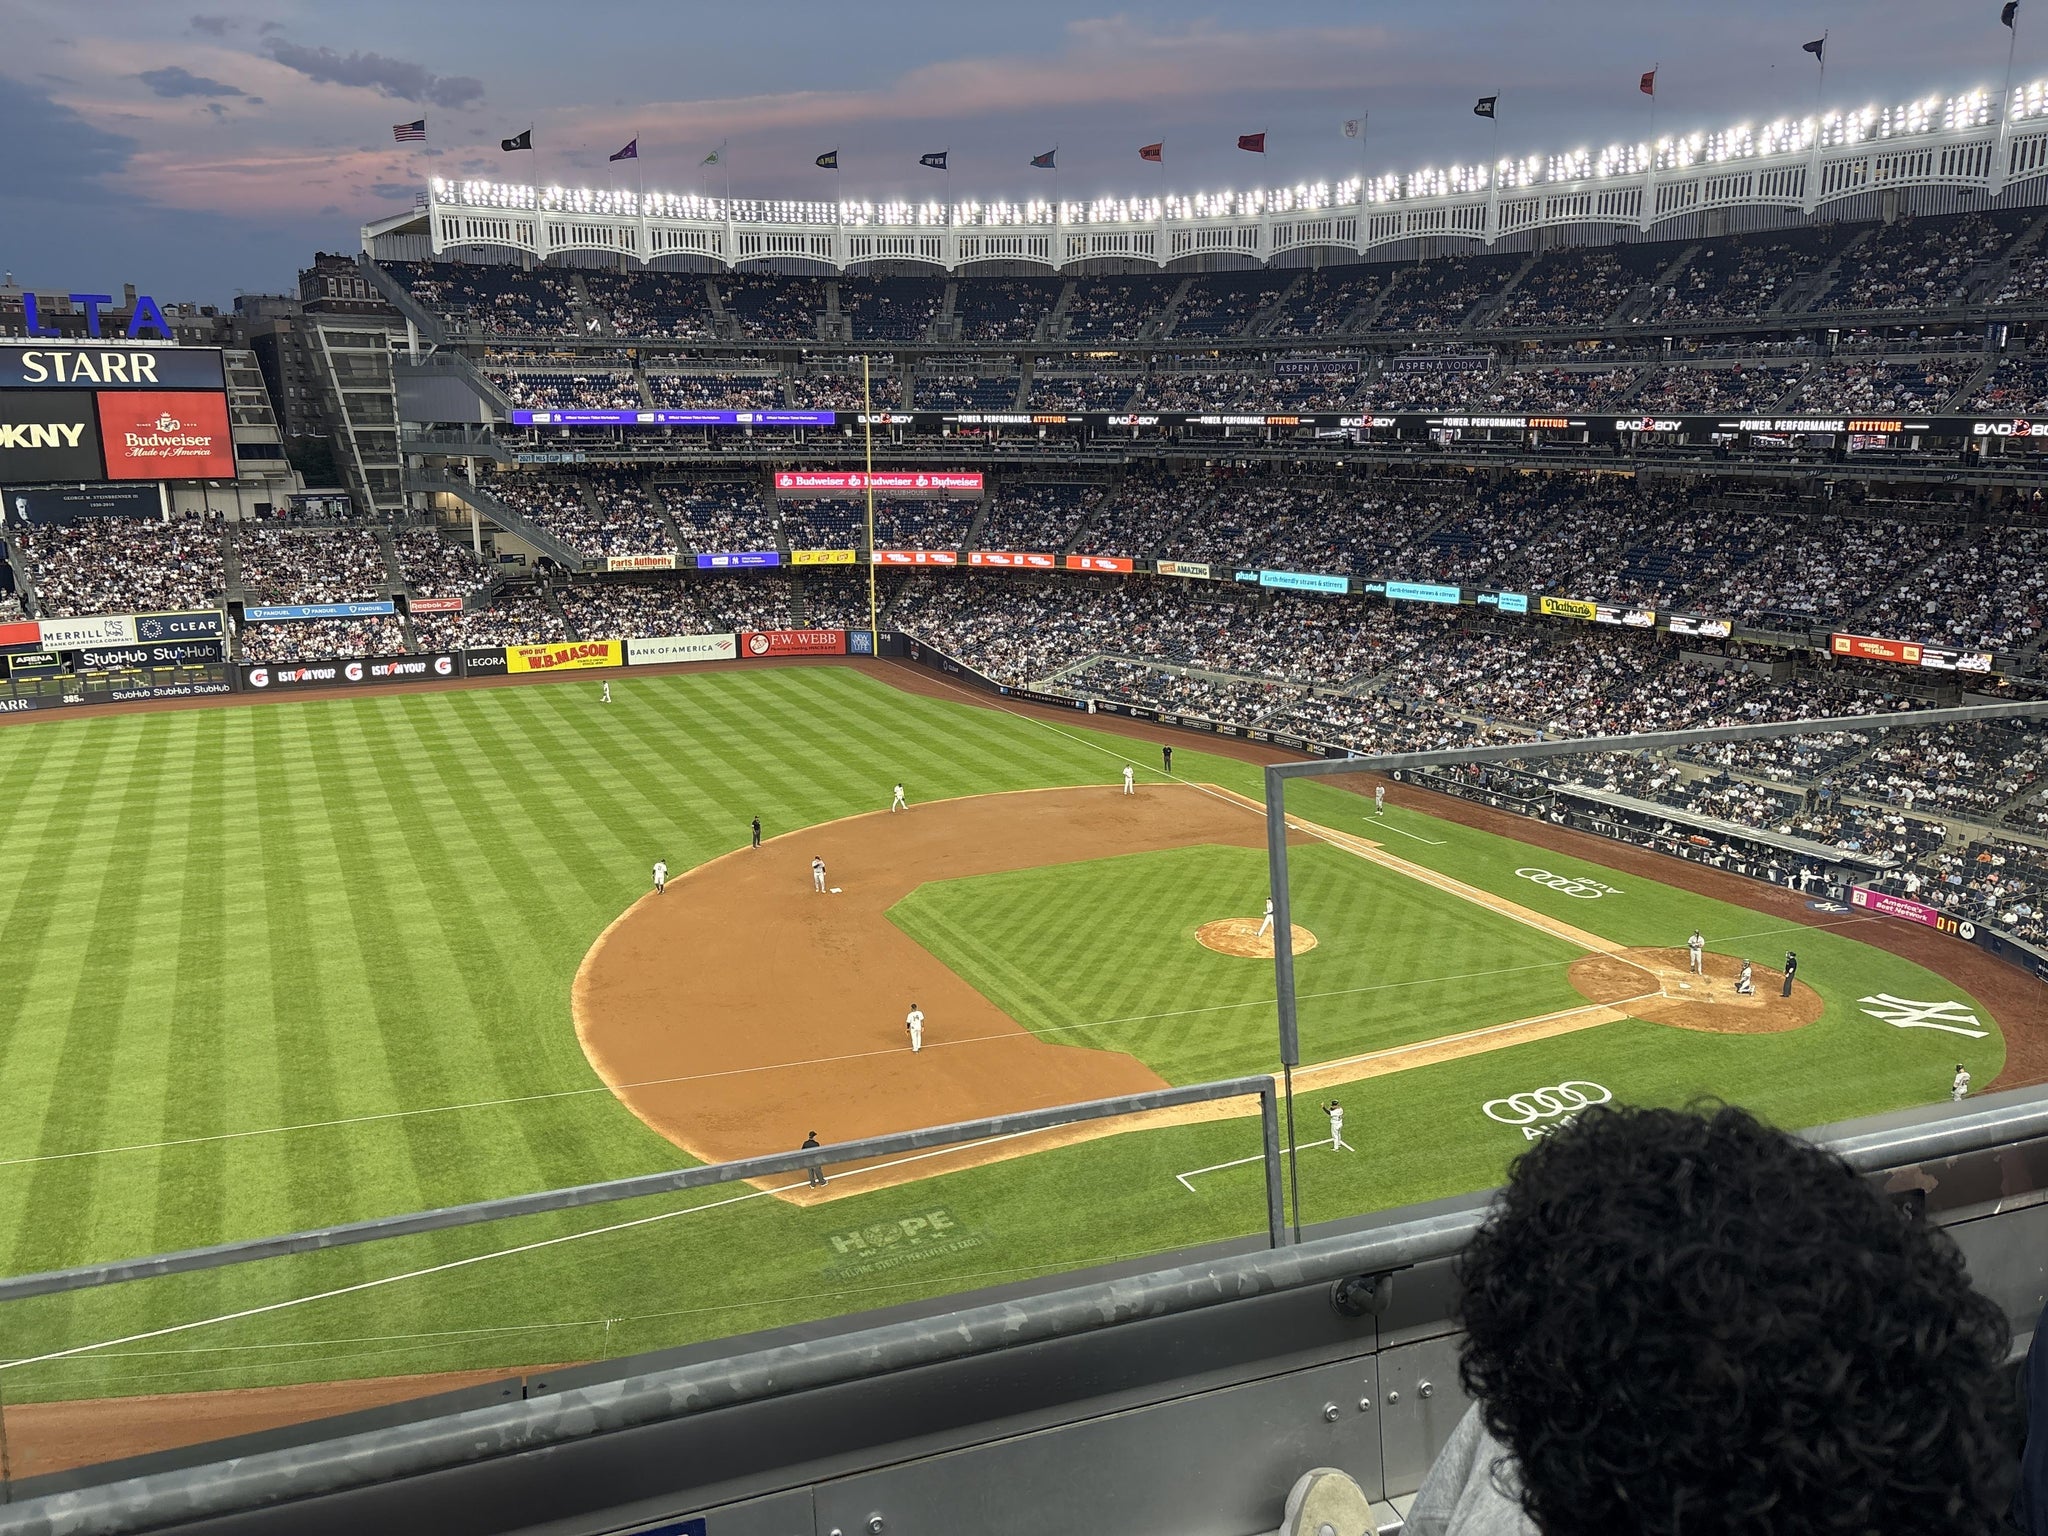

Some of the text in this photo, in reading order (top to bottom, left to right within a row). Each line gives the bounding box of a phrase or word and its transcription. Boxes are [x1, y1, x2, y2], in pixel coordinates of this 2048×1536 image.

[21, 351, 159, 383] STARR
[1279, 363, 1354, 372] ASPEN VODKA
[1399, 361, 1483, 370] ASPEN VODKA
[858, 415, 913, 424] BAD BOY
[958, 415, 982, 423] POWER.
[983, 415, 1032, 424] PERFORMANCE.
[1108, 416, 1159, 425] BAD BOY
[1200, 416, 1221, 425] POWER.
[1222, 416, 1266, 425] PERFORMANCE.
[1340, 417, 1396, 427] BAD BOY
[1443, 417, 1470, 427] POWER.
[1471, 418, 1528, 428] PERFORMANCE.
[1616, 420, 1682, 431] BAD BOY
[1739, 420, 1773, 431] POWER.
[1774, 420, 1846, 432] PERFORMANCE.
[1973, 423, 2012, 435] BAD
[0, 423, 85, 448] KNY
[124, 433, 212, 447] Budweiser
[125, 447, 211, 458] Made of America
[796, 476, 845, 485] Budweiser
[863, 476, 912, 485] Budweiser
[931, 476, 979, 486] Budweiser
[611, 556, 672, 567] Parts Authority
[1177, 566, 1208, 575] AMAZING
[1322, 581, 1343, 589] stirrers
[1545, 599, 1591, 615] Nathan's
[170, 621, 217, 632] CLEAR
[44, 630, 103, 641] MERRILL
[771, 633, 837, 645] F.W. WEBB
[153, 645, 216, 660] StubHub
[630, 648, 655, 656] BANK
[672, 645, 713, 653] AMERICA
[16, 653, 53, 664] ARENA
[83, 648, 148, 666] StubHub
[467, 657, 506, 667] LEGORA
[311, 668, 336, 680] YOU?
[403, 662, 426, 674] YOU?
[112, 683, 230, 700] StubHub StubHub StubHub
[63, 694, 80, 704] 385
[1573, 877, 1625, 894] Audi
[1876, 902, 1928, 921] Best Network
[1883, 898, 1923, 914] America's
